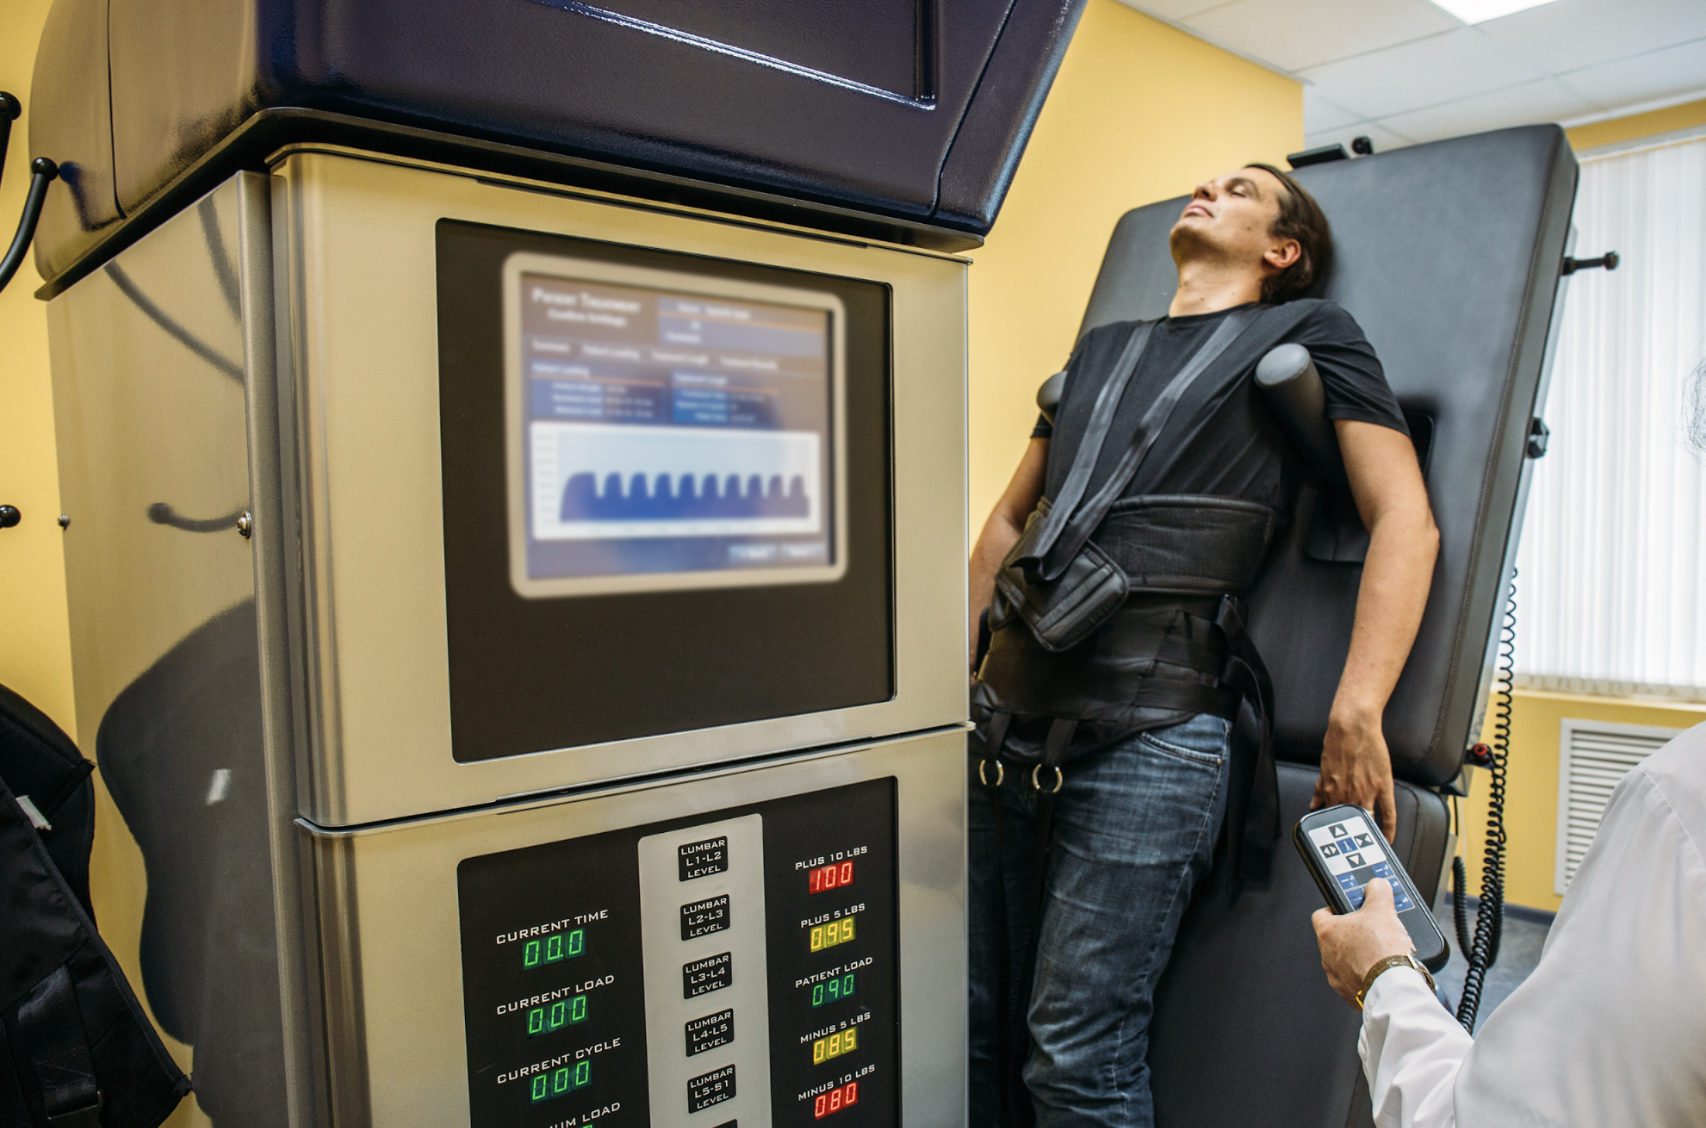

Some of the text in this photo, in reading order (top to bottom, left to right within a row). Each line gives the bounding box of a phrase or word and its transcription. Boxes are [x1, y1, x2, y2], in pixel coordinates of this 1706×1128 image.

[680, 839, 725, 855] LUMBAR
[795, 846, 868, 871] PLUS 10 LBS
[686, 851, 721, 867] L1-L2
[687, 865, 721, 878] LEVEL
[816, 862, 852, 891] 100
[683, 897, 727, 915] LUMBAR
[688, 909, 723, 926] L2-L3
[801, 903, 865, 928] PLUS 5 LBS
[496, 909, 608, 944] CURRENT TIME
[690, 923, 723, 937] LEVEL
[810, 918, 852, 950] 095
[525, 929, 583, 966] 00.0
[685, 955, 729, 974] LUMBAR
[691, 967, 725, 984] L3-L4
[795, 957, 873, 988] PATIENT LOAD
[497, 975, 614, 1015] CURRENT LOAD
[692, 980, 725, 995] LEVEL
[812, 974, 854, 1006] 090
[529, 996, 586, 1034] 000
[688, 1011, 731, 1032] LUMBAR
[693, 1023, 728, 1042] L4-L5
[800, 1012, 871, 1044] MINUS 5 LBS
[694, 1037, 727, 1053] LEVEL
[813, 1028, 855, 1062] 085
[497, 1037, 621, 1084] CURRENT CYCLE
[532, 1060, 589, 1100] 000
[690, 1067, 733, 1089] LUMBAR
[694, 1080, 729, 1099] L5-S1
[798, 1064, 876, 1101] MINUS 10 LBS
[697, 1093, 729, 1109] LEVEL
[815, 1082, 857, 1118] 080
[582, 1102, 620, 1122] LOAD
